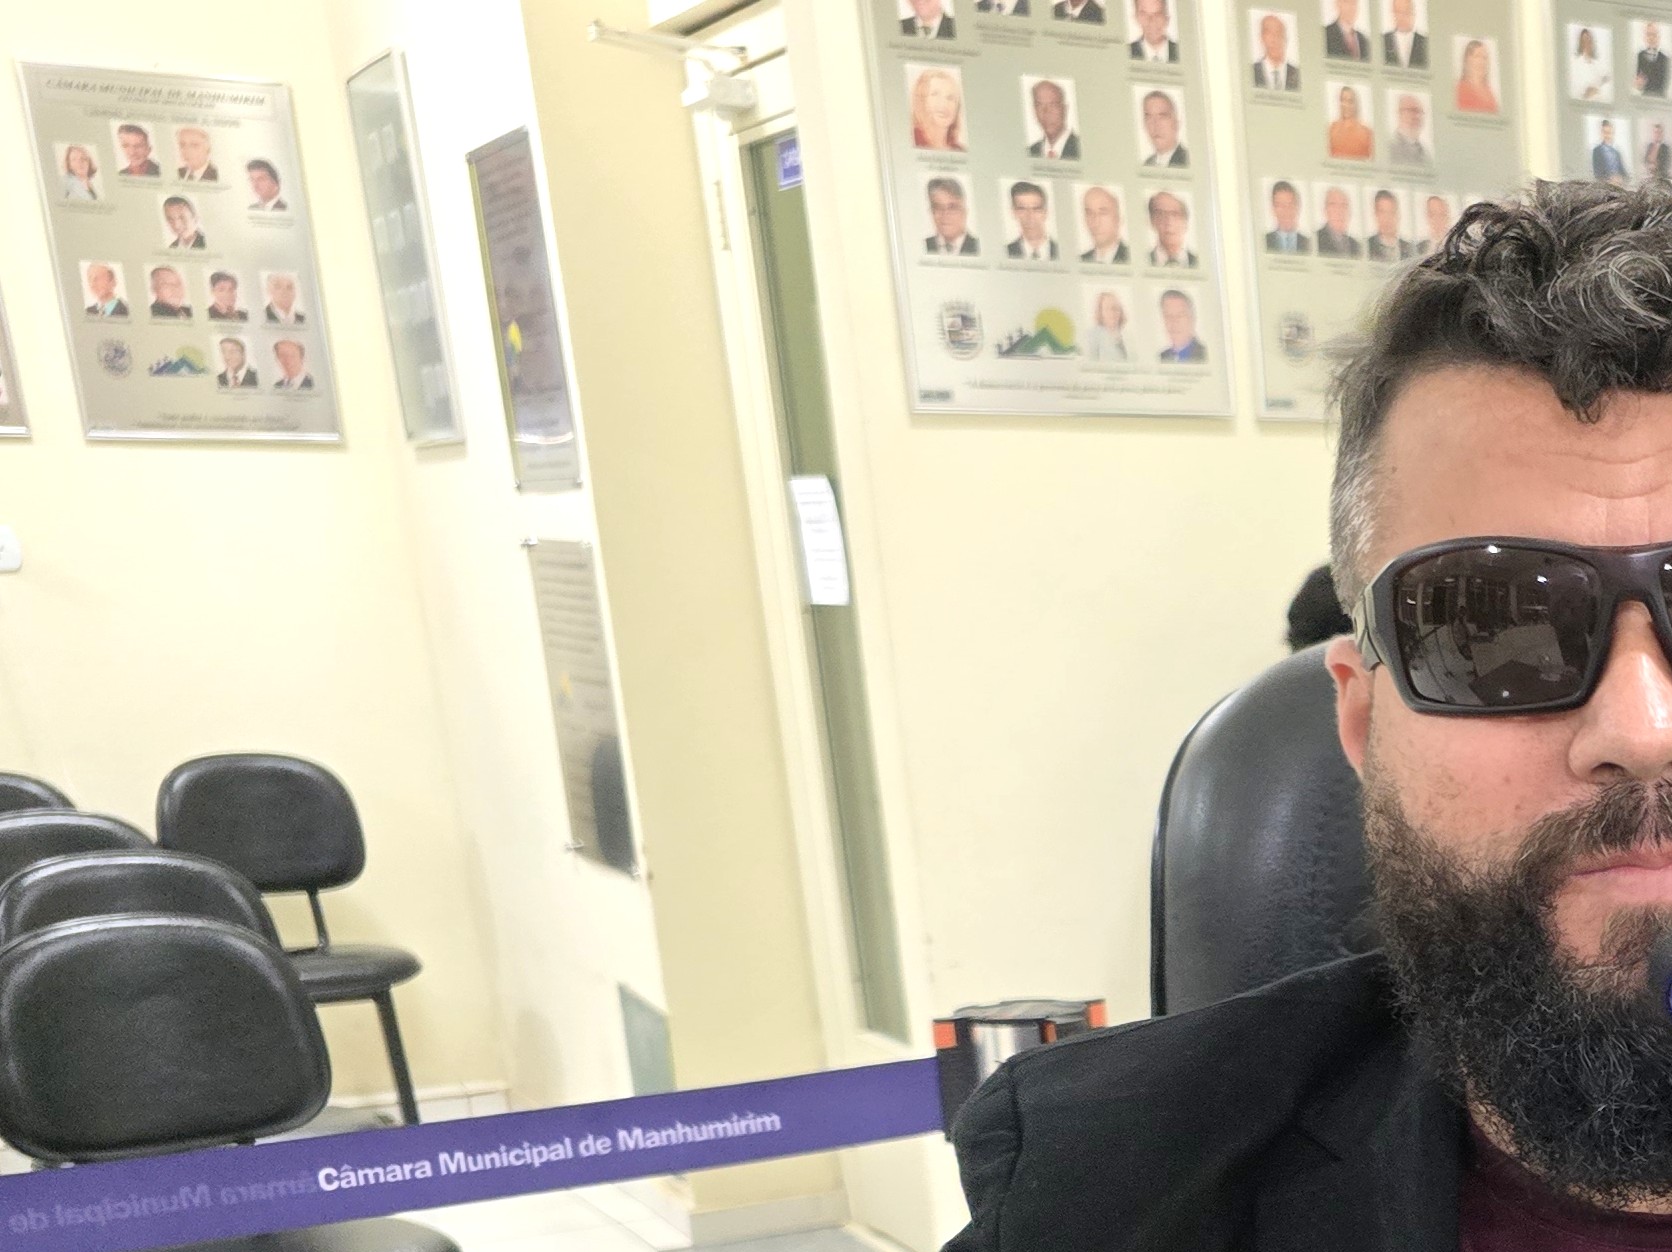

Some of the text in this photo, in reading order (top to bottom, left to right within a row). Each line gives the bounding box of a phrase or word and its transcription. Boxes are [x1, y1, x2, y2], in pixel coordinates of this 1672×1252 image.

[318, 1112, 782, 1191] Câmara Municipal de Manhumirim
